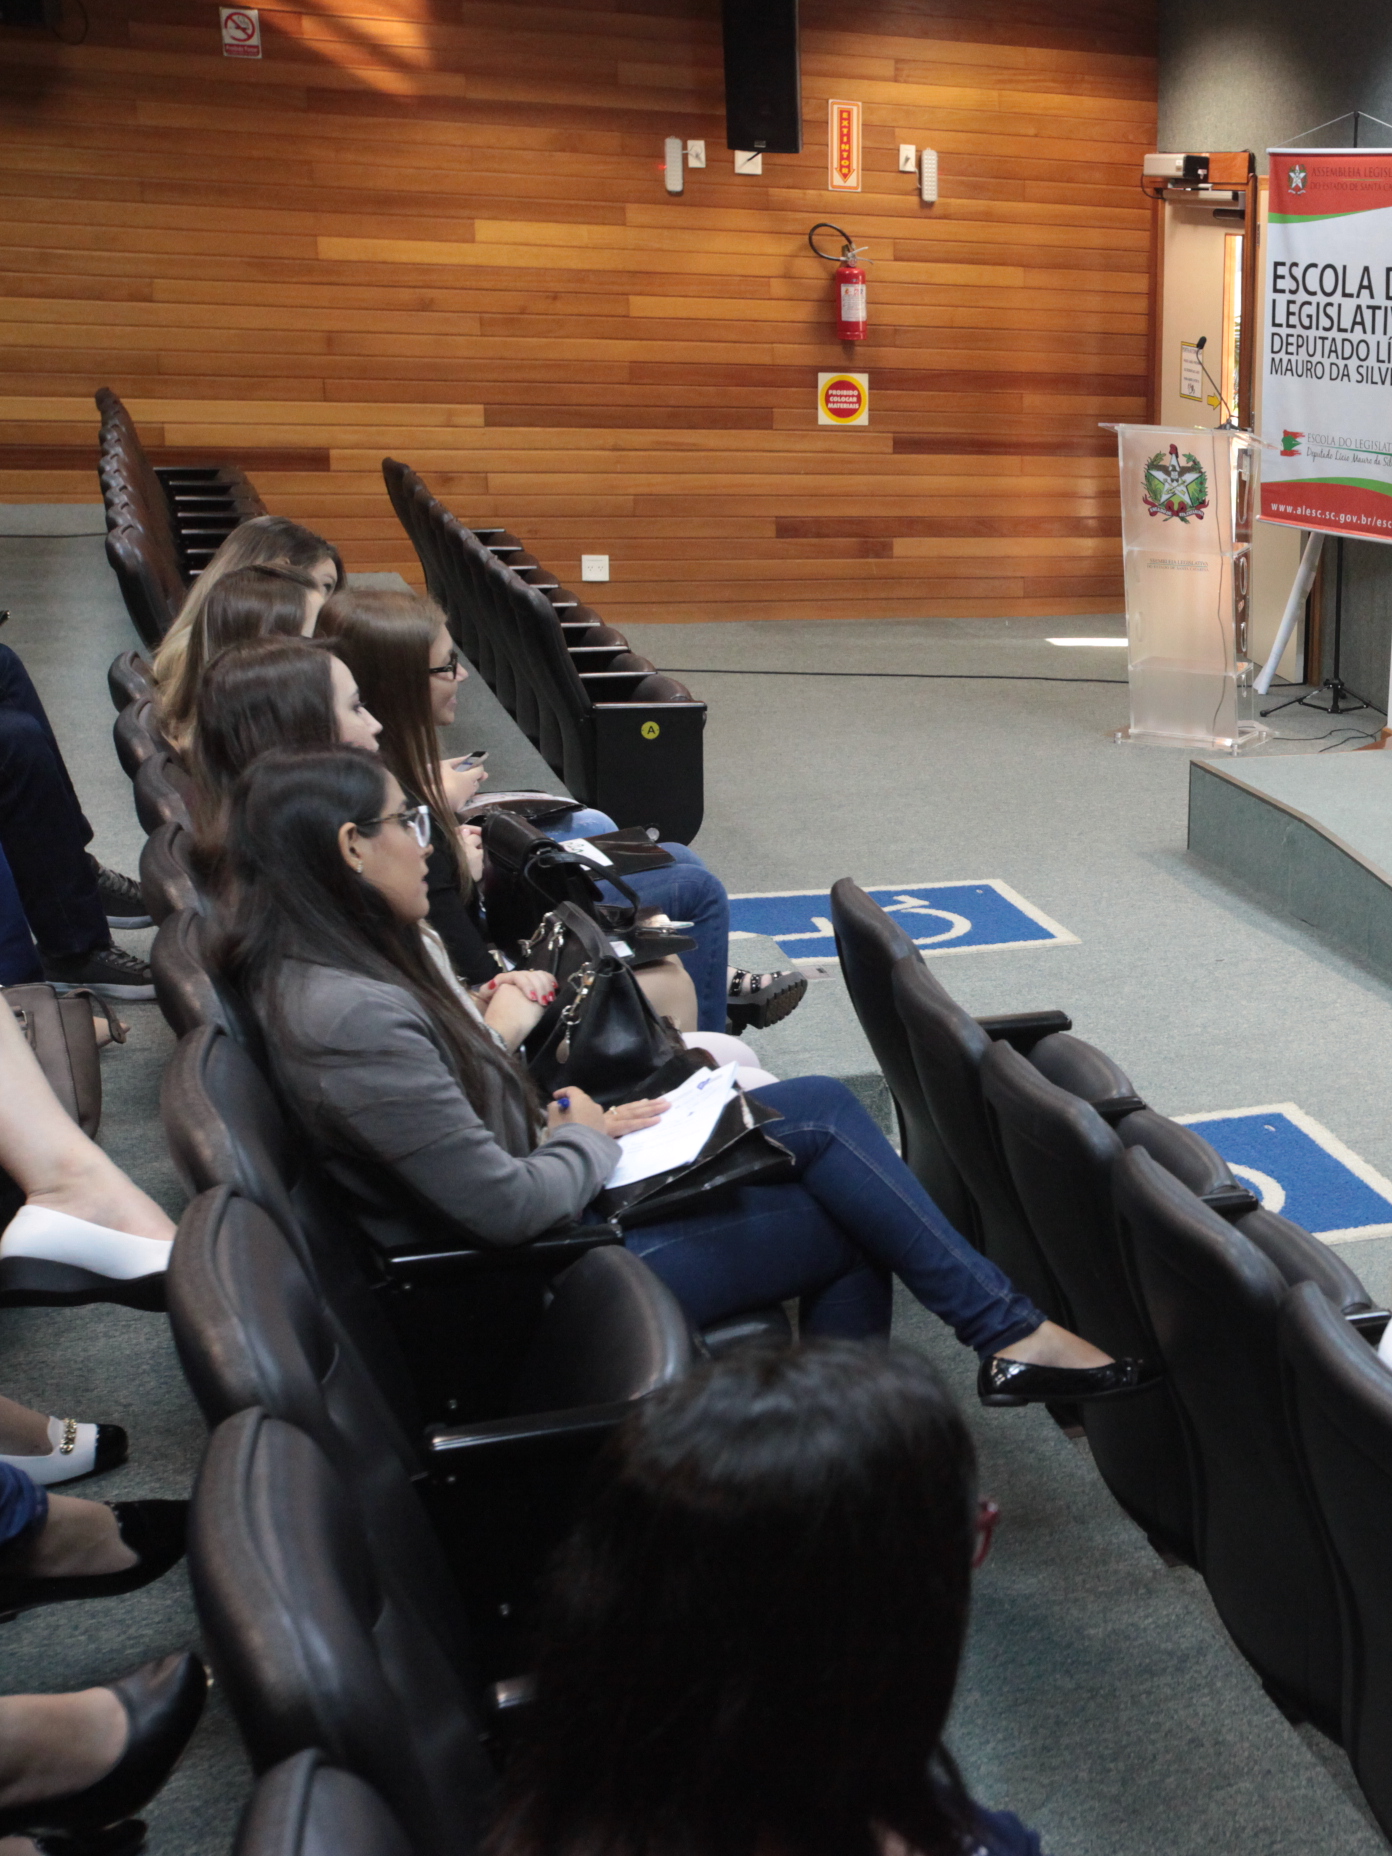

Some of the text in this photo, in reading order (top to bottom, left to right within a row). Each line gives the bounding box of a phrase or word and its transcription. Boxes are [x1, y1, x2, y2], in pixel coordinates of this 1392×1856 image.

[841, 112, 850, 174] EXTINTOR
[1311, 167, 1361, 178] ASSEMBLEIA
[1272, 261, 1375, 300] ESCOLA
[1270, 332, 1370, 362] DEPUTADO
[1270, 357, 1325, 380] MAURO
[1329, 362, 1351, 382] DA
[1307, 433, 1336, 446] ESCOLA
[1338, 437, 1352, 447] DO
[1306, 446, 1333, 462] Deputado
[647, 725, 656, 735] A
